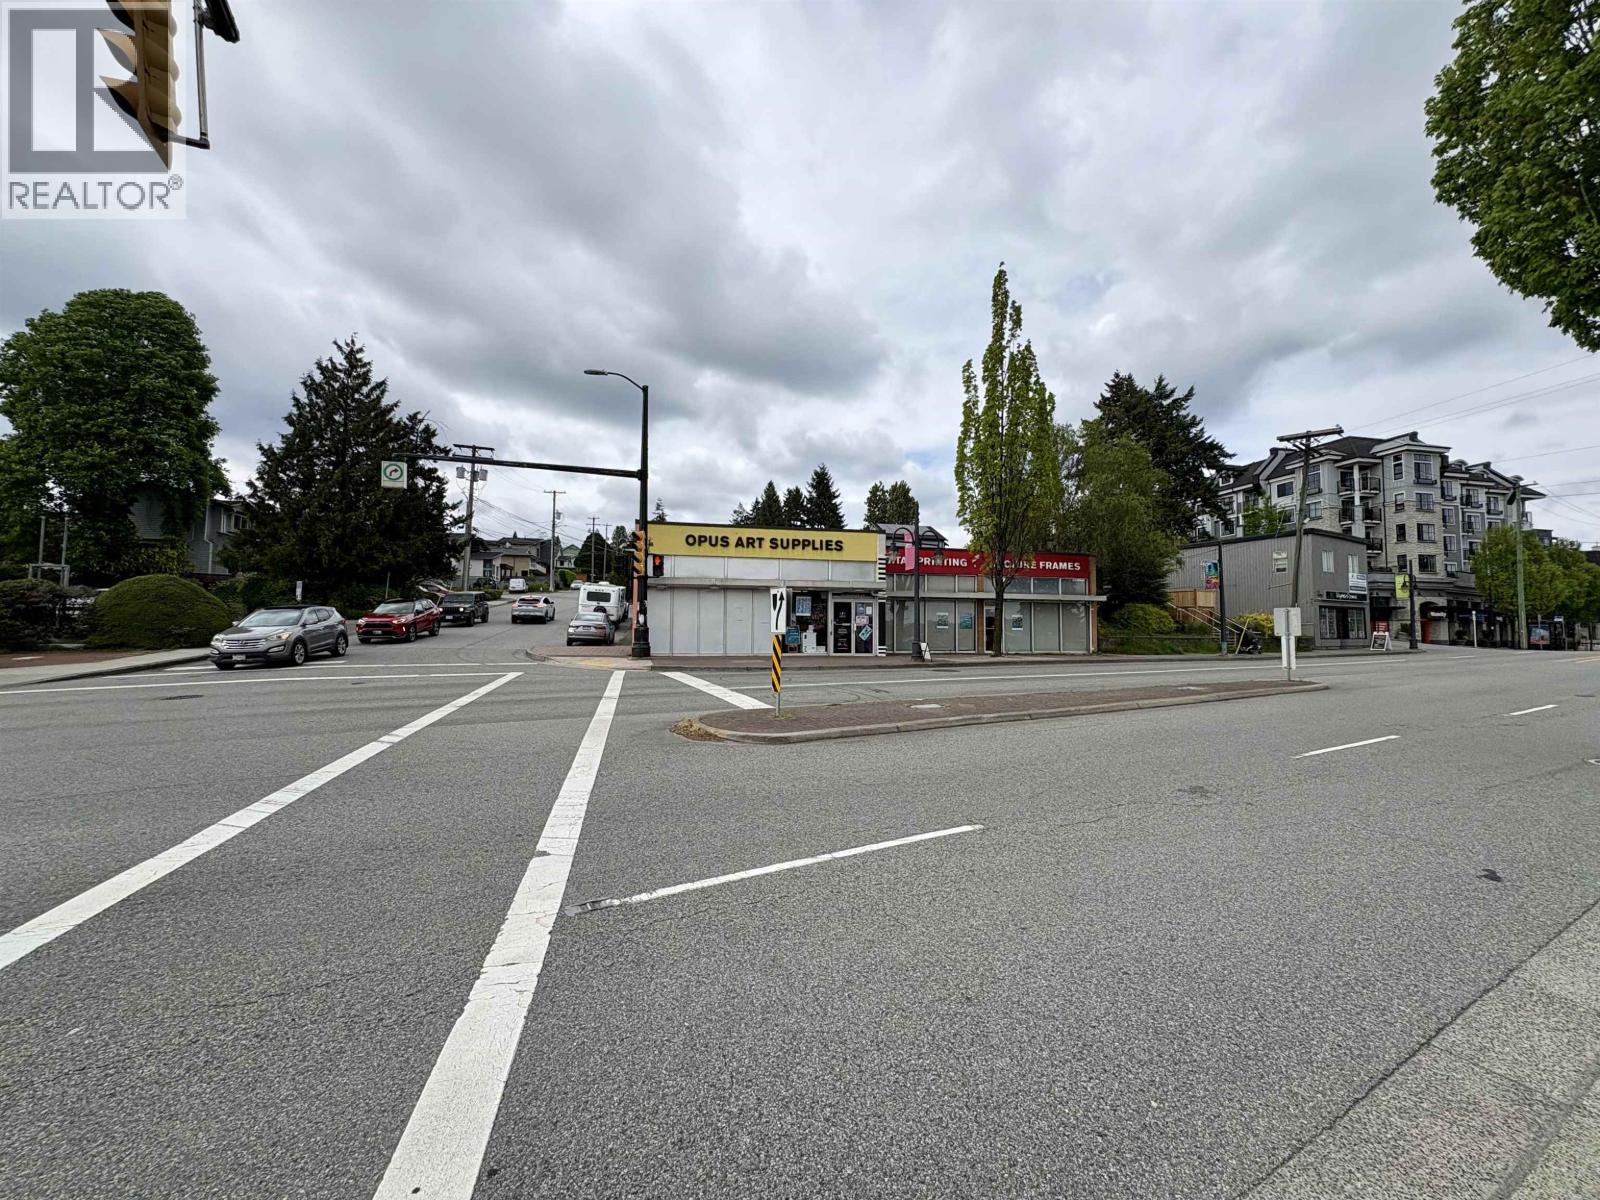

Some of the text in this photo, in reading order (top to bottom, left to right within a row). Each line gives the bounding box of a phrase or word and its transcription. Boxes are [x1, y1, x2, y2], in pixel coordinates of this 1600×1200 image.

[685, 534, 844, 551] OPUS ART SUPPLIES
[918, 557, 967, 567] PRITING
[1039, 561, 1081, 570] FRAMES
